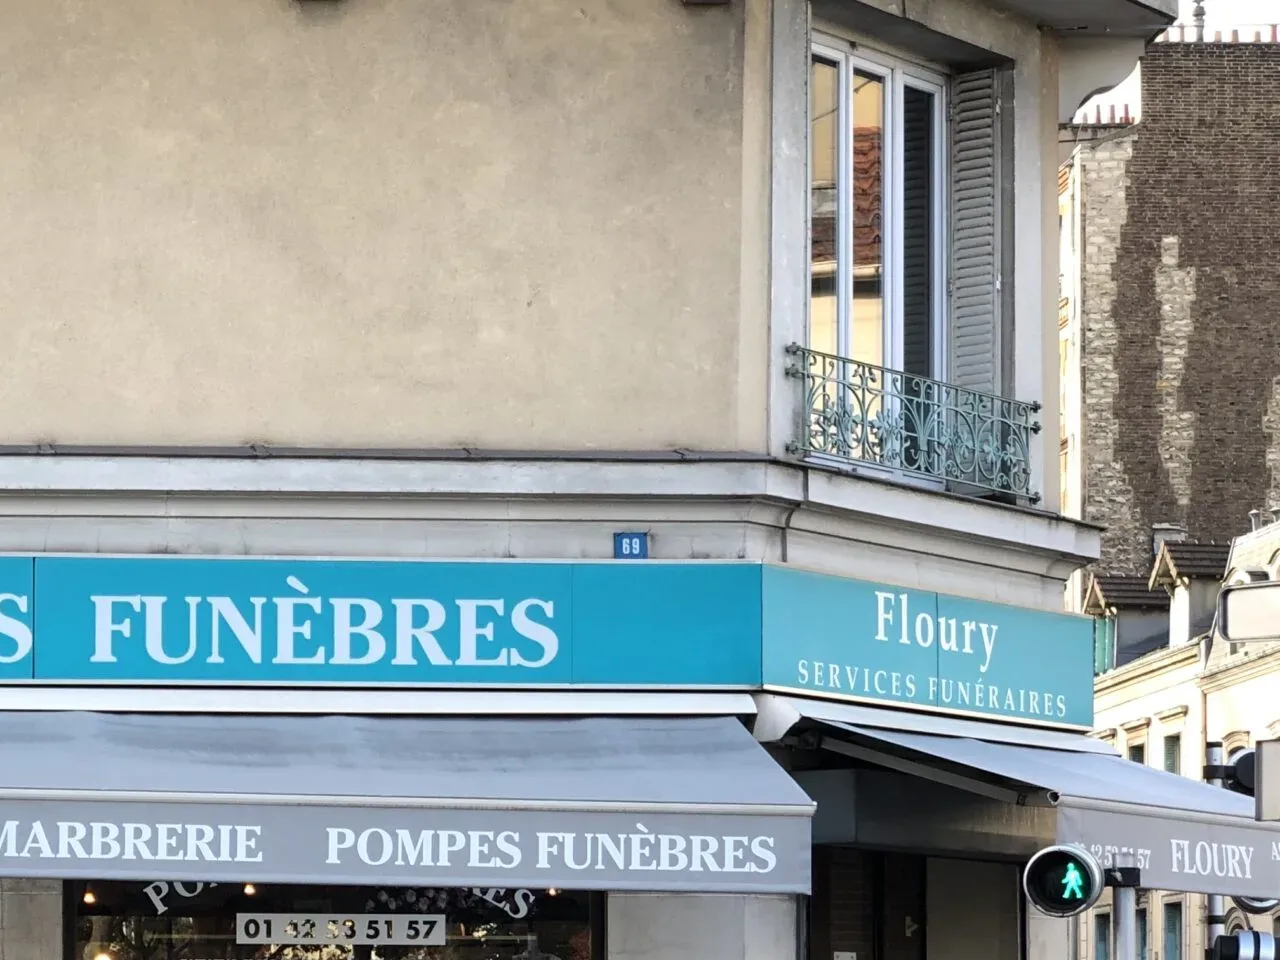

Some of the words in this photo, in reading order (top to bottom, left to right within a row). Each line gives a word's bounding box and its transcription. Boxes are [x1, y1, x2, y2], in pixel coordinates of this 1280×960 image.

[622, 538, 640, 555] 69
[90, 575, 558, 668] FUNÈBRES
[875, 590, 999, 672] Floury
[798, 660, 916, 698] SERVICES
[928, 677, 1067, 717] FUNÉRAIRES
[326, 828, 522, 868] POMPES
[536, 824, 777, 873] FUNÈBRES
[1170, 839, 1254, 879] FLOURY
[244, 919, 272, 938] 01
[366, 920, 393, 939] 51
[407, 920, 438, 939] 57
